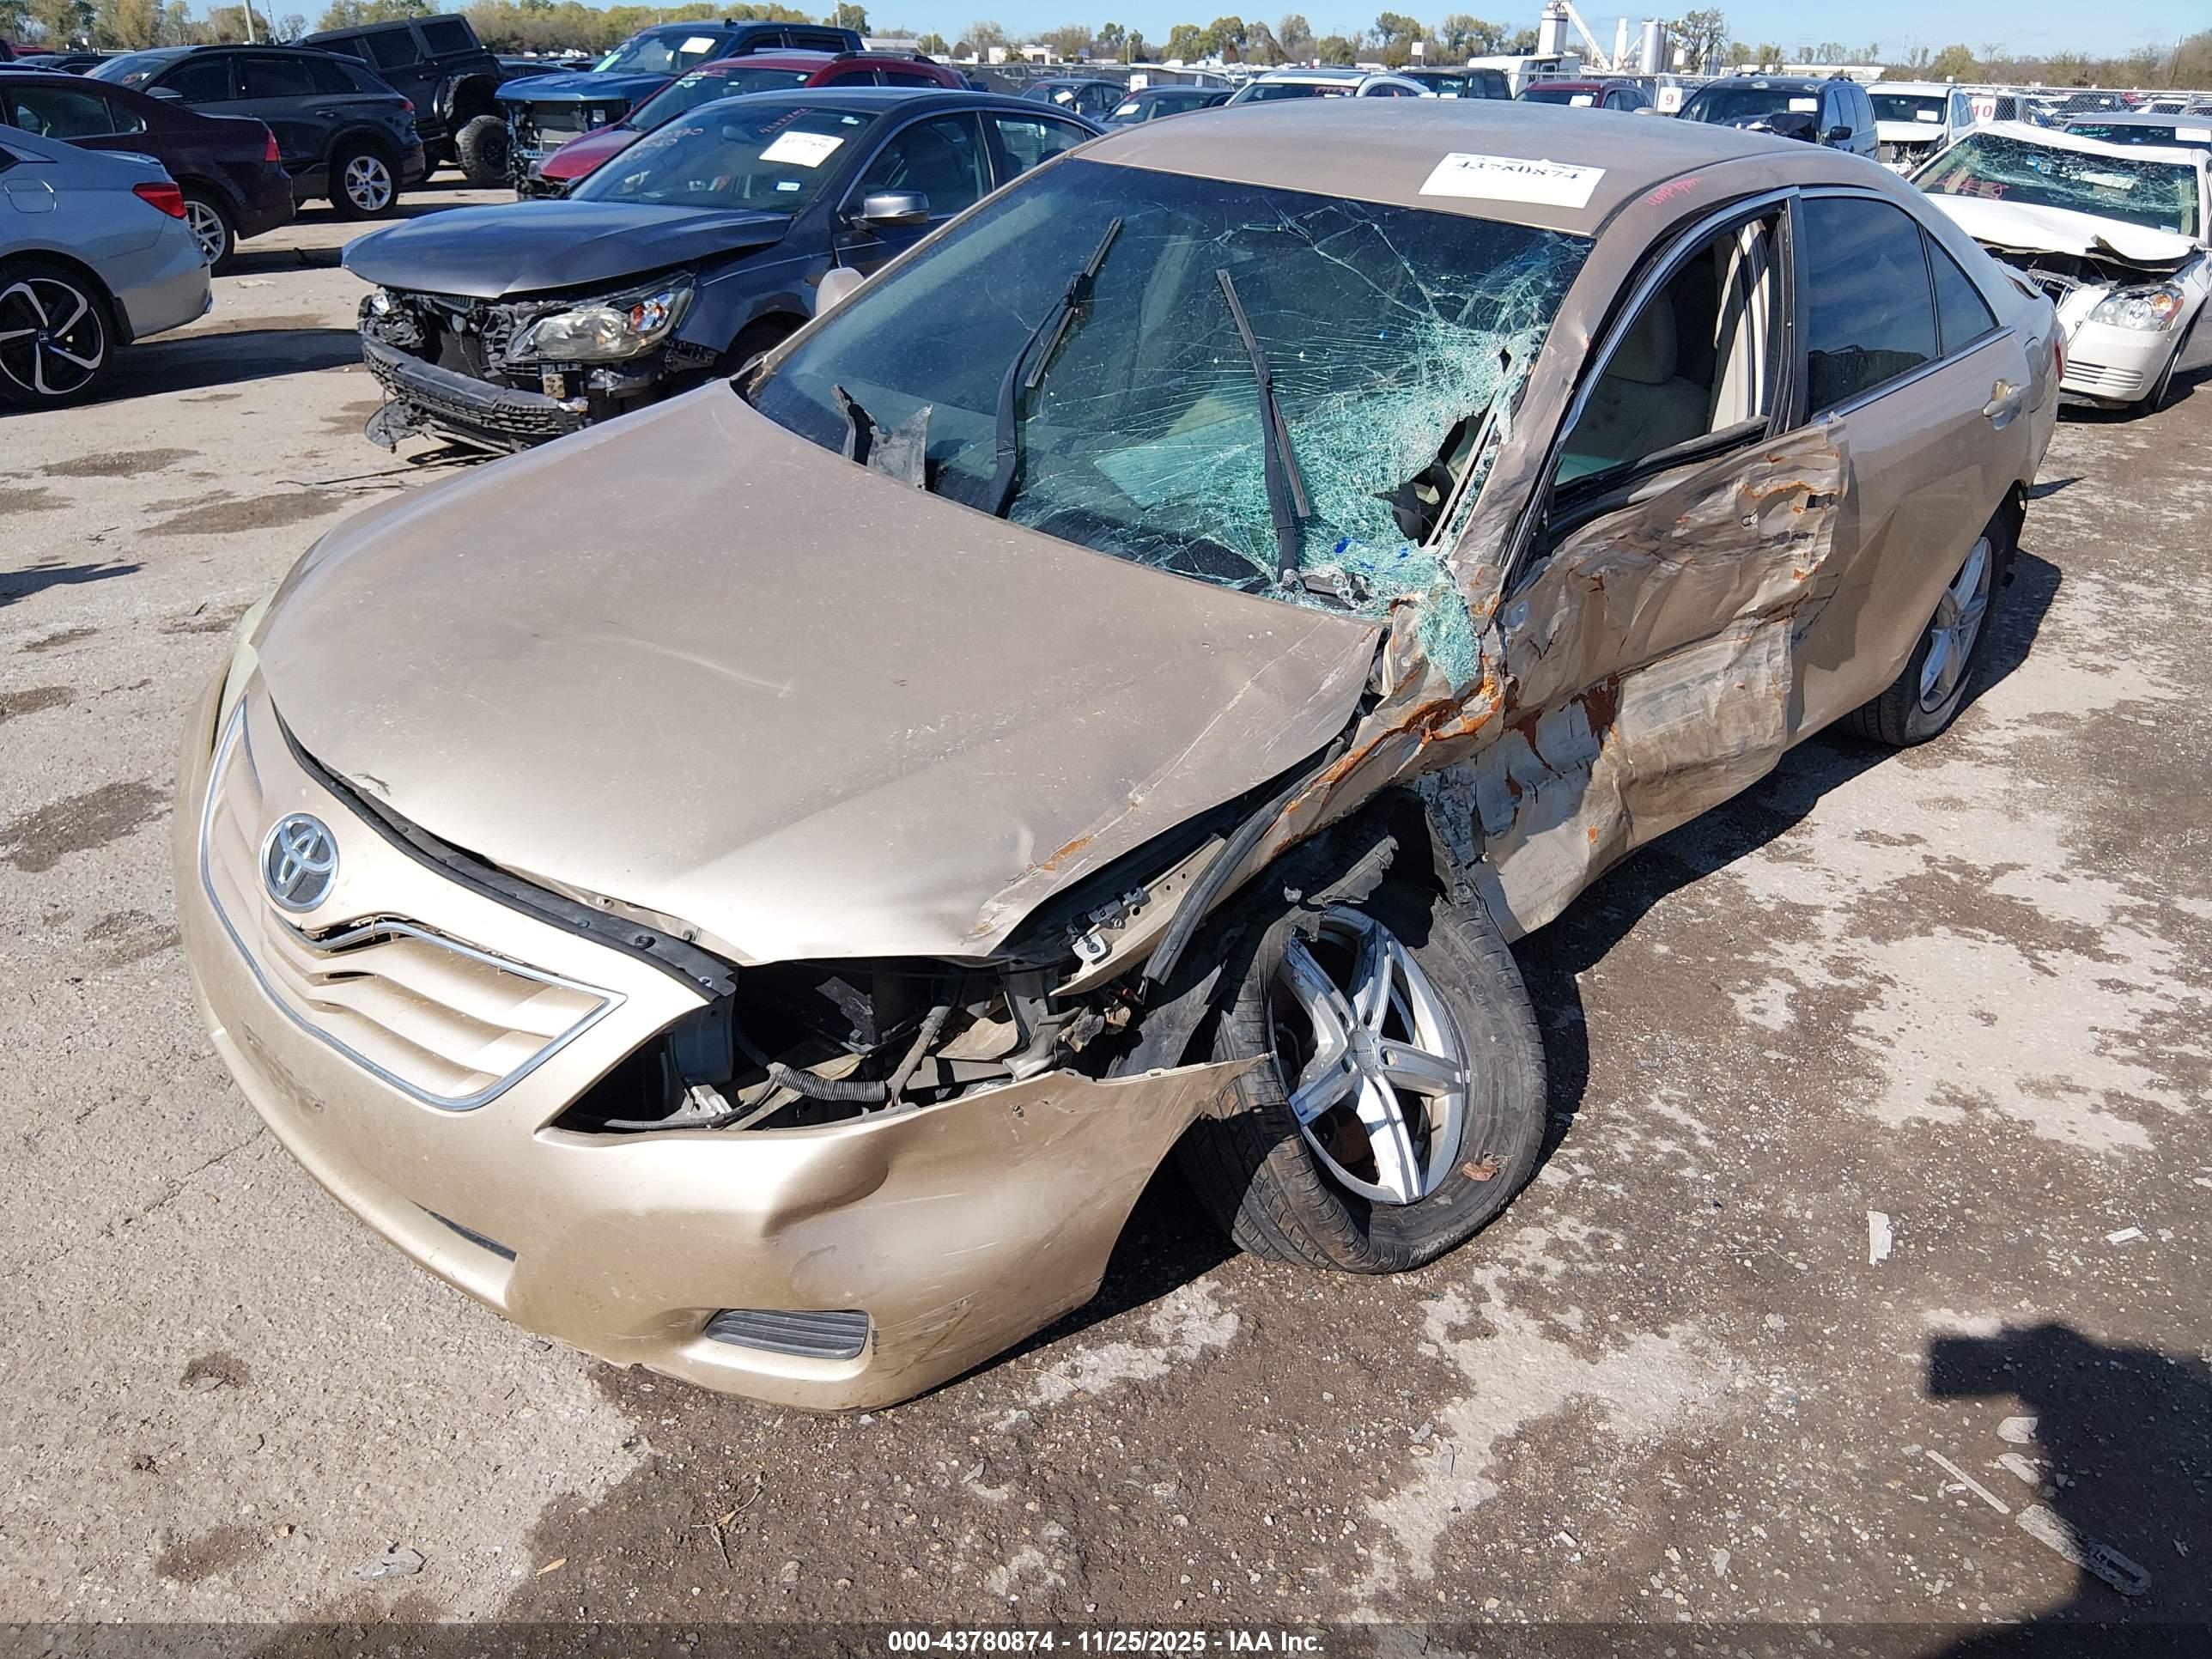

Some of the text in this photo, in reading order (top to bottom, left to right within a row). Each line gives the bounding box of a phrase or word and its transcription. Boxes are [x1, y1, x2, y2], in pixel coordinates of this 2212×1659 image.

[1665, 94, 1674, 106] 9
[1972, 104, 1993, 118] 10
[1455, 160, 1580, 180] 43780874
